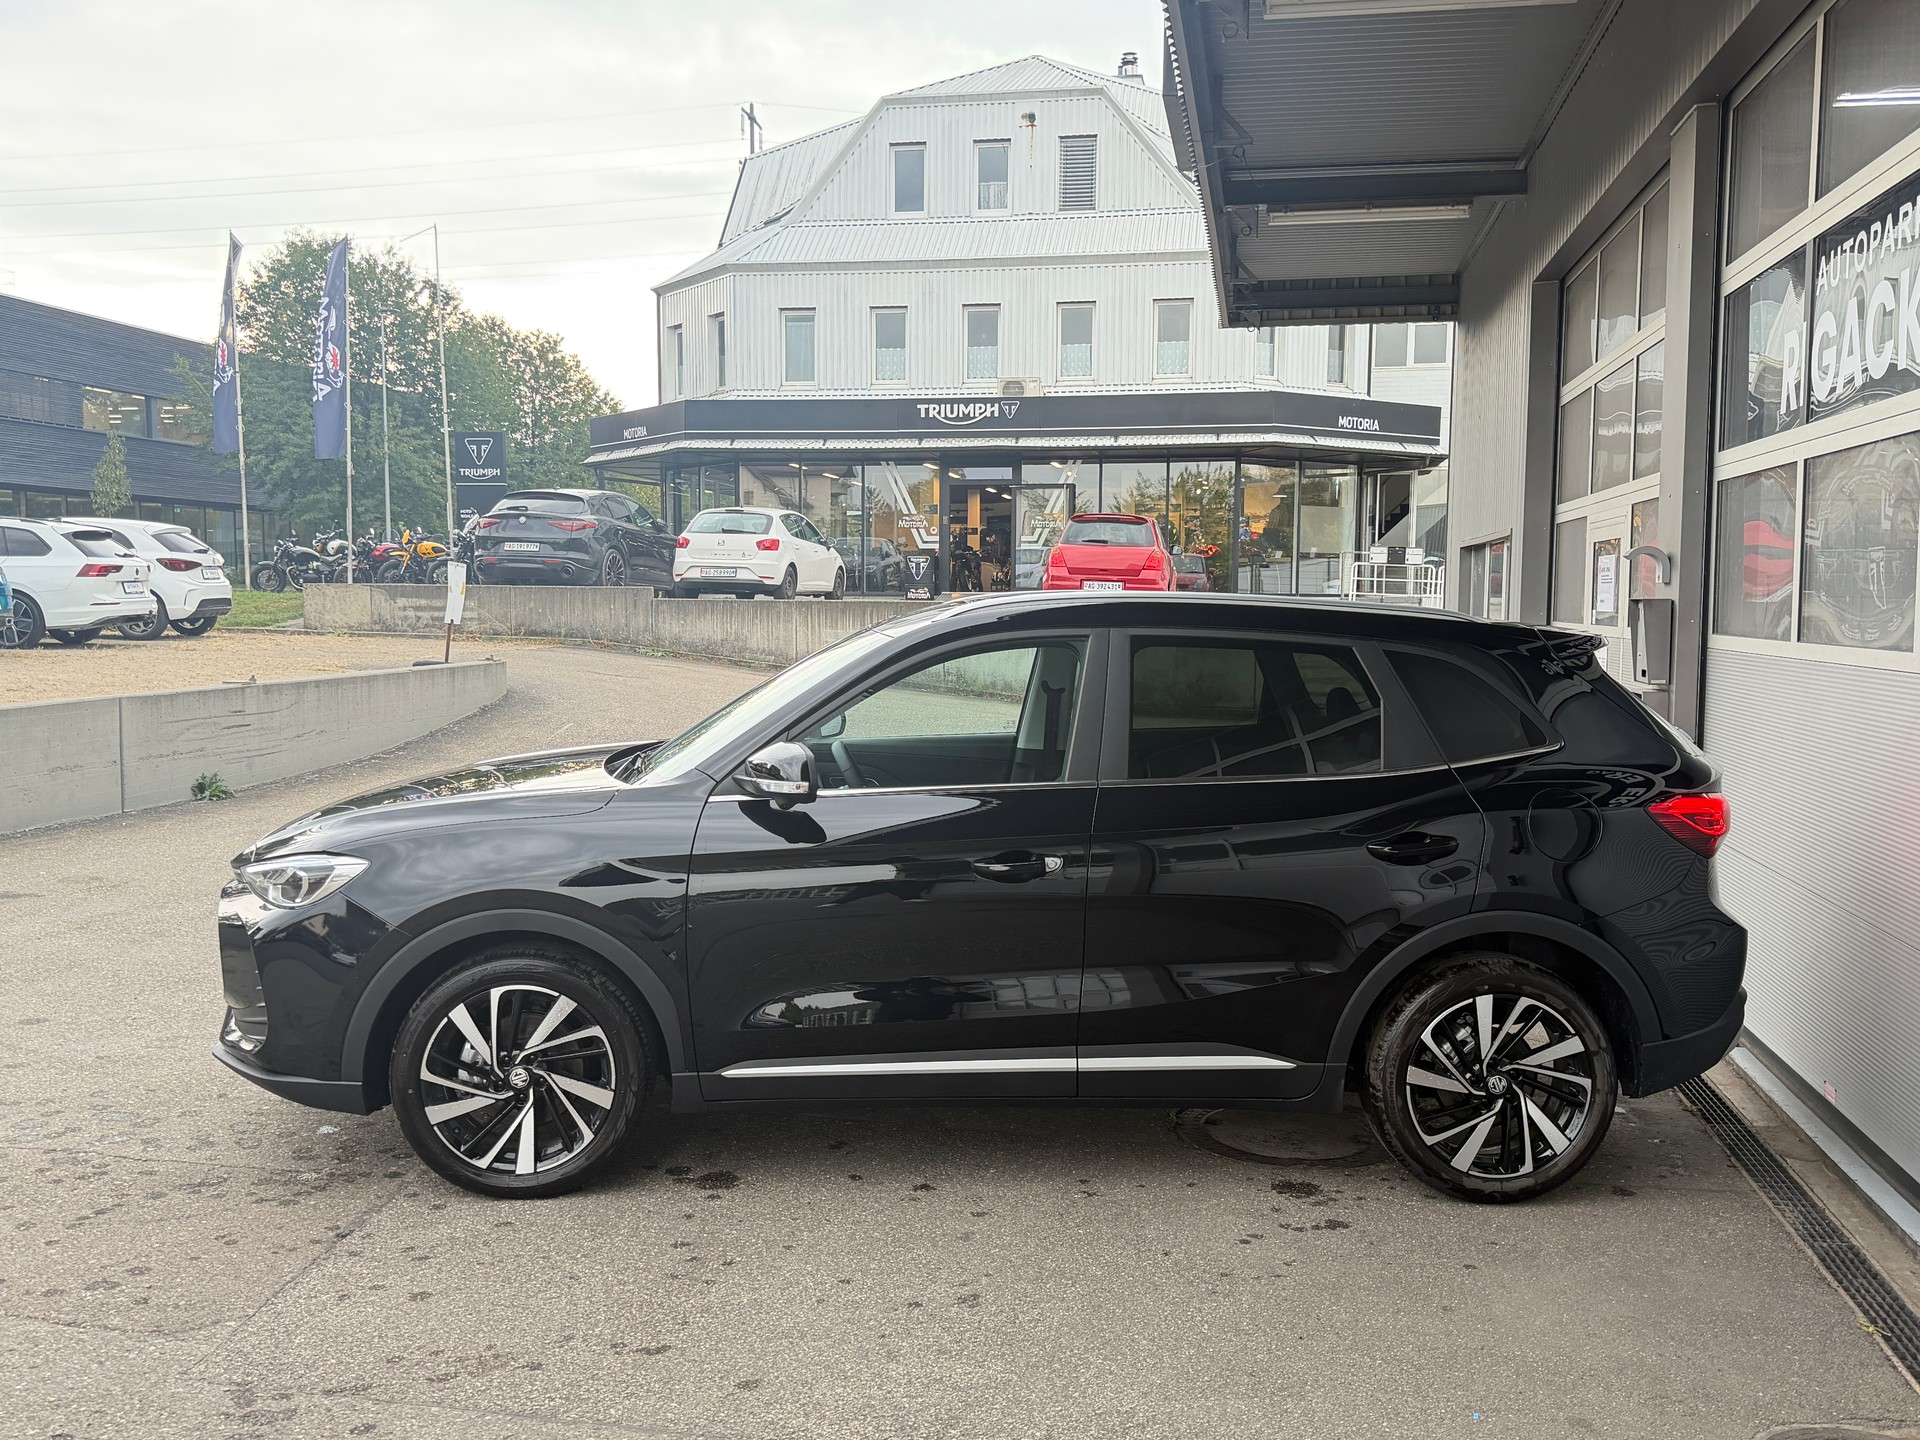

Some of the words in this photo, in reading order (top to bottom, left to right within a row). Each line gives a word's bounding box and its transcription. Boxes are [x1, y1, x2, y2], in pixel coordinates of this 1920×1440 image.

[1816, 195, 1920, 296] AUTOPAR
[1780, 267, 1920, 415] RIGACK
[916, 403, 999, 425] TRIUMPH
[1338, 415, 1380, 431] MOTORIA
[623, 425, 648, 440] MOTORIA
[459, 468, 501, 480] TRIUMPH
